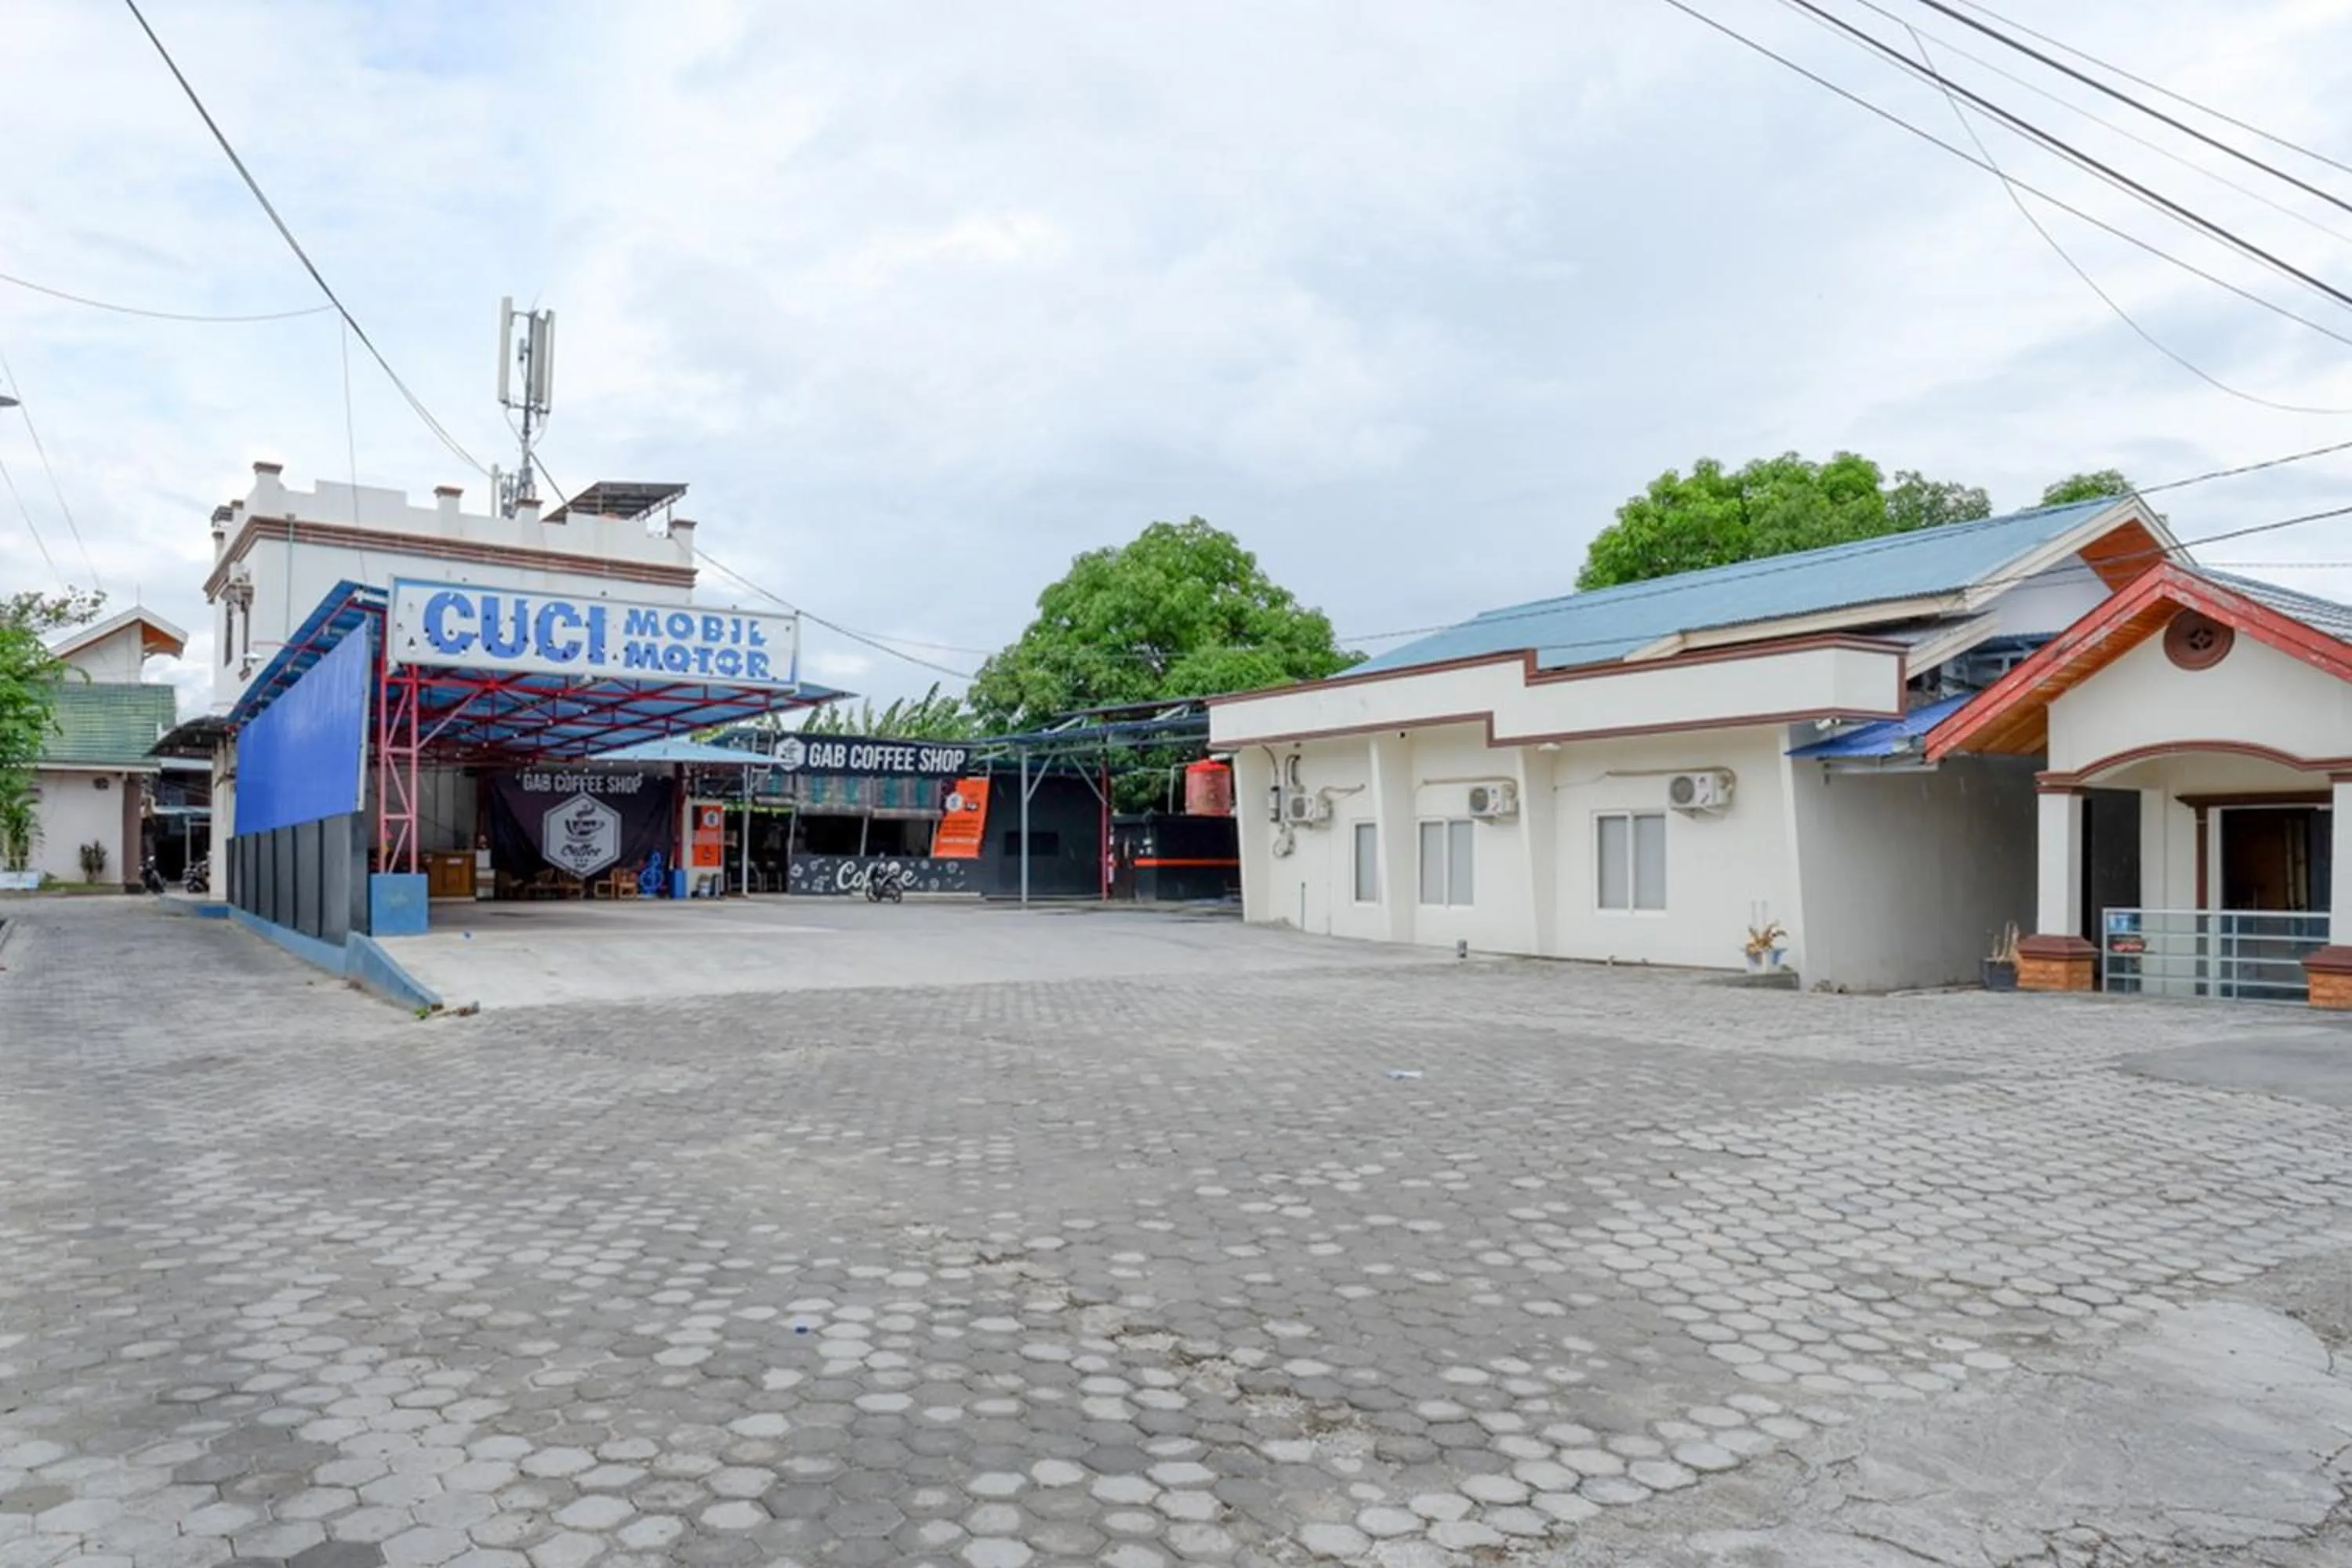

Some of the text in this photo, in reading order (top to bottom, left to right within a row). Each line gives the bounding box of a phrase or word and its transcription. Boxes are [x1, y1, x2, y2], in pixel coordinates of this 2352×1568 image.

[423, 591, 606, 664] CUCI
[624, 608, 767, 646] MOBIL
[624, 640, 770, 677] MOTOR
[809, 743, 965, 773] GAB COFFEE SHOP
[523, 773, 642, 794] GAB COFFEE SHOP
